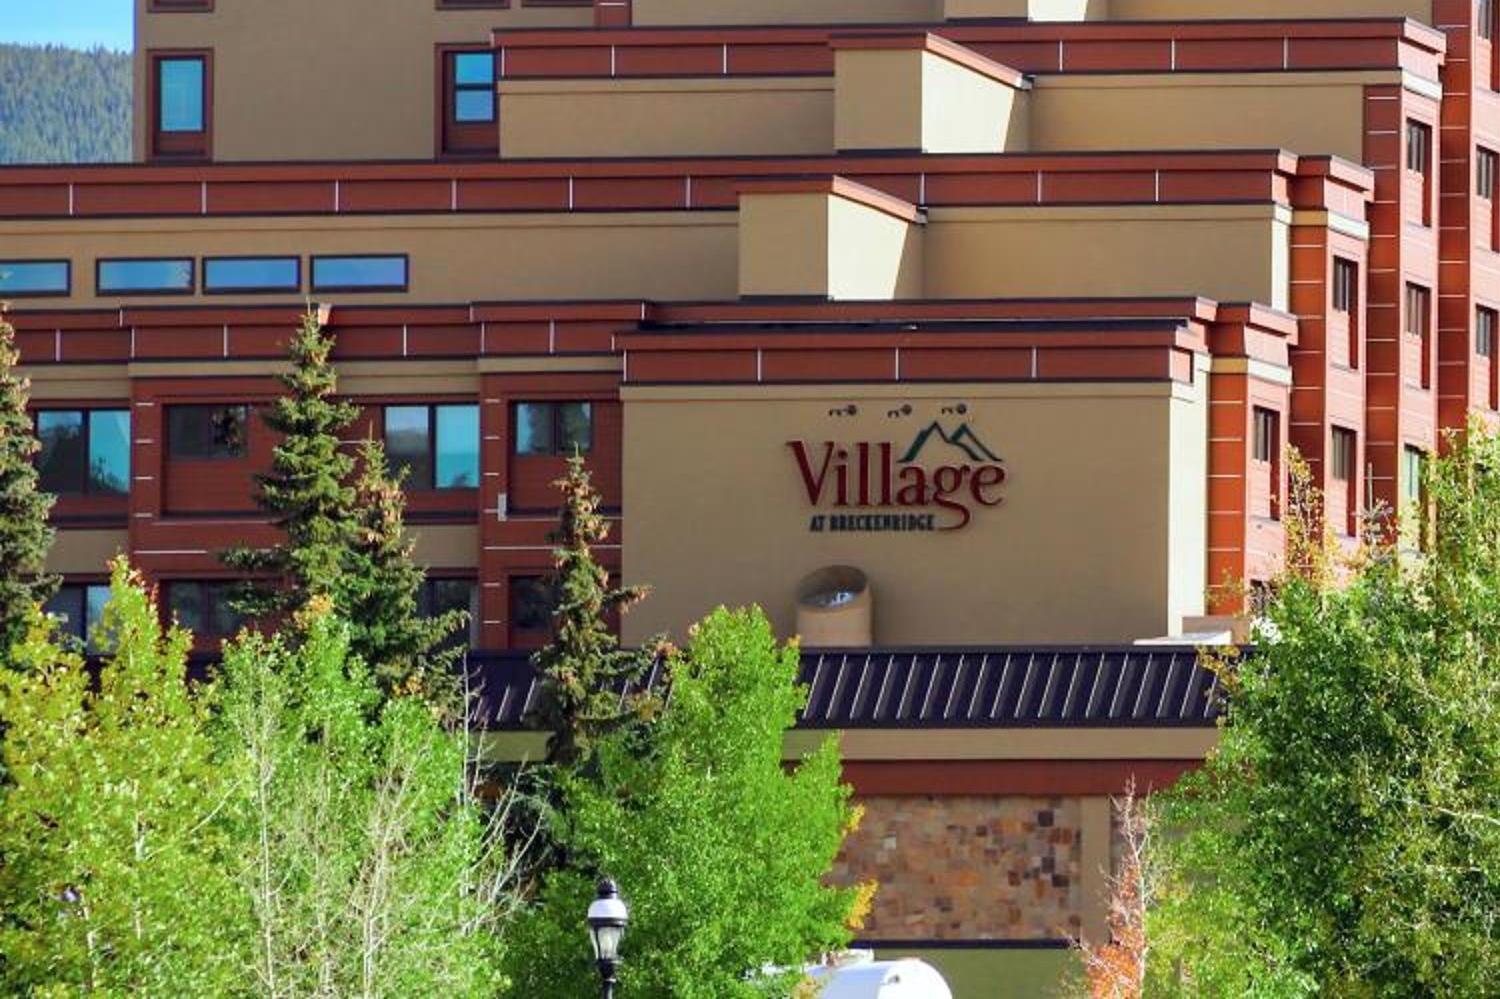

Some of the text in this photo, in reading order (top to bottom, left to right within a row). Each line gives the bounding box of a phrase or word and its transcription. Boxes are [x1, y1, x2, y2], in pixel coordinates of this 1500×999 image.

[786, 440, 1006, 532] Village
[809, 513, 936, 532] AT BRECKENRIDGE
